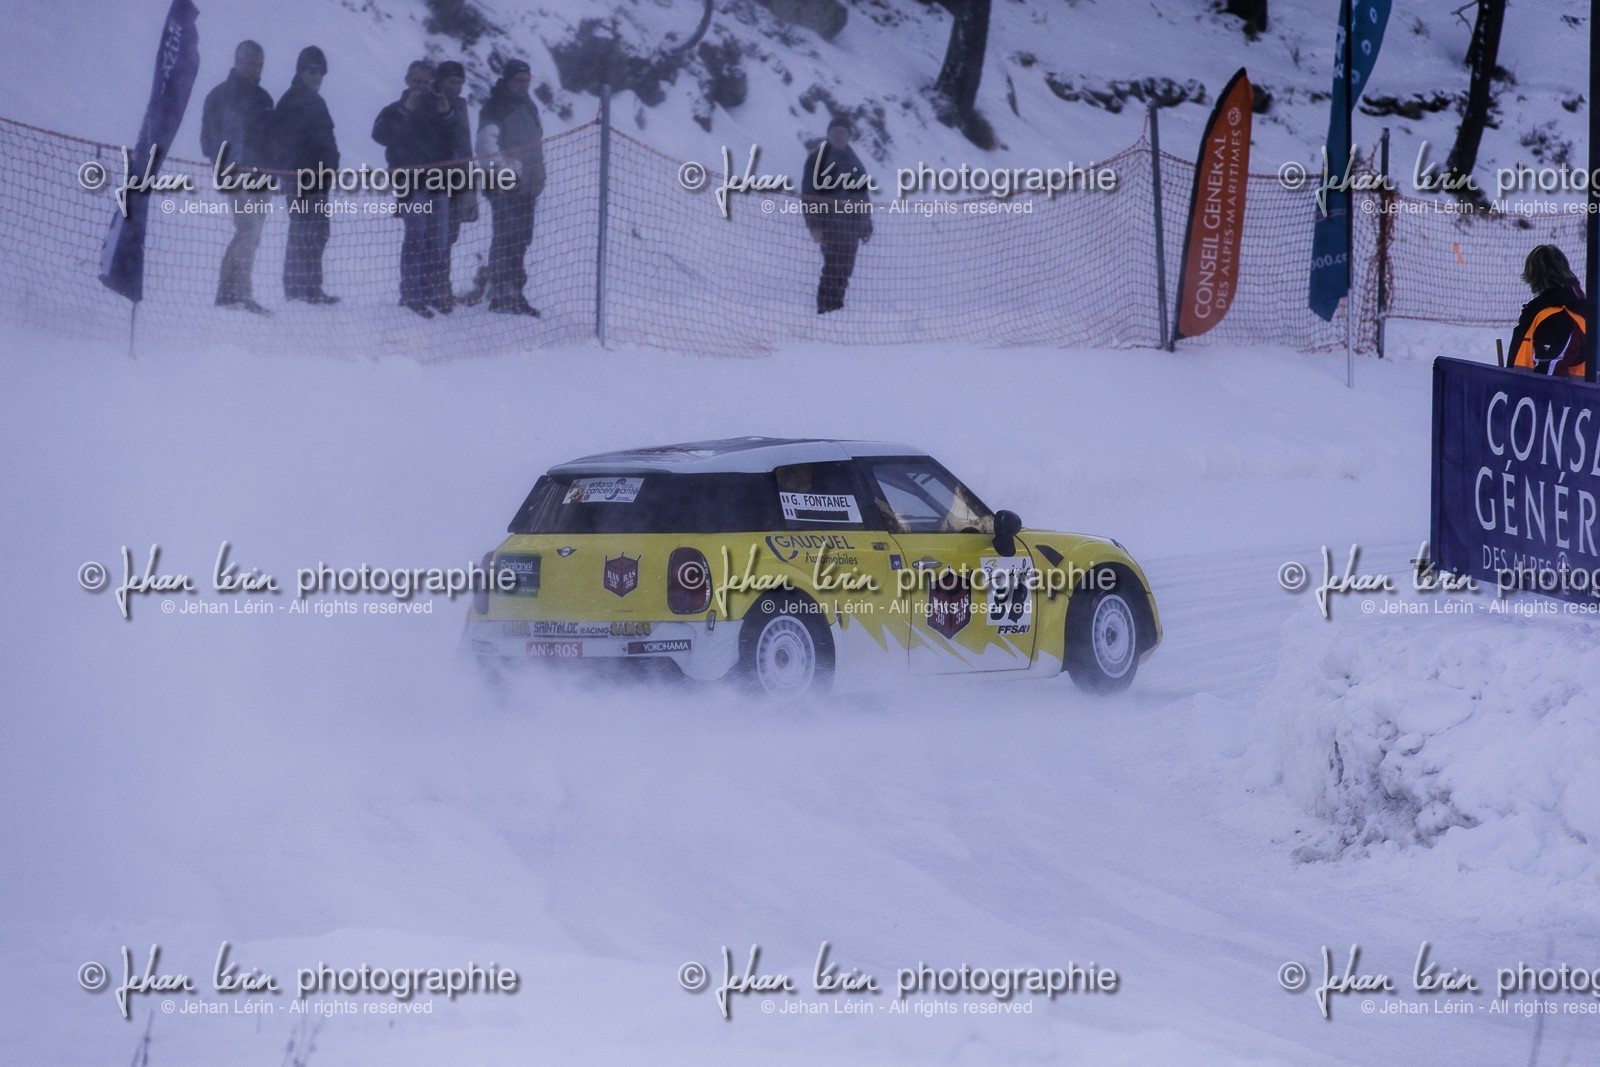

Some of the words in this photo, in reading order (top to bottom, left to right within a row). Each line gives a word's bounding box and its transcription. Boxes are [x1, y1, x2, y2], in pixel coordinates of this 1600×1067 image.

[1194, 234, 1220, 319] CONSEIL
[1216, 280, 1230, 309] DES
[790, 494, 801, 506] G.
[804, 495, 851, 508] FONTANEL
[774, 535, 855, 550] GAUDUEL
[805, 551, 858, 566] Auomobiles
[1483, 544, 1508, 573] DES
[580, 627, 610, 635] RACING
[998, 625, 1026, 635] FFSA
[643, 642, 690, 652] YOKOHAMA
